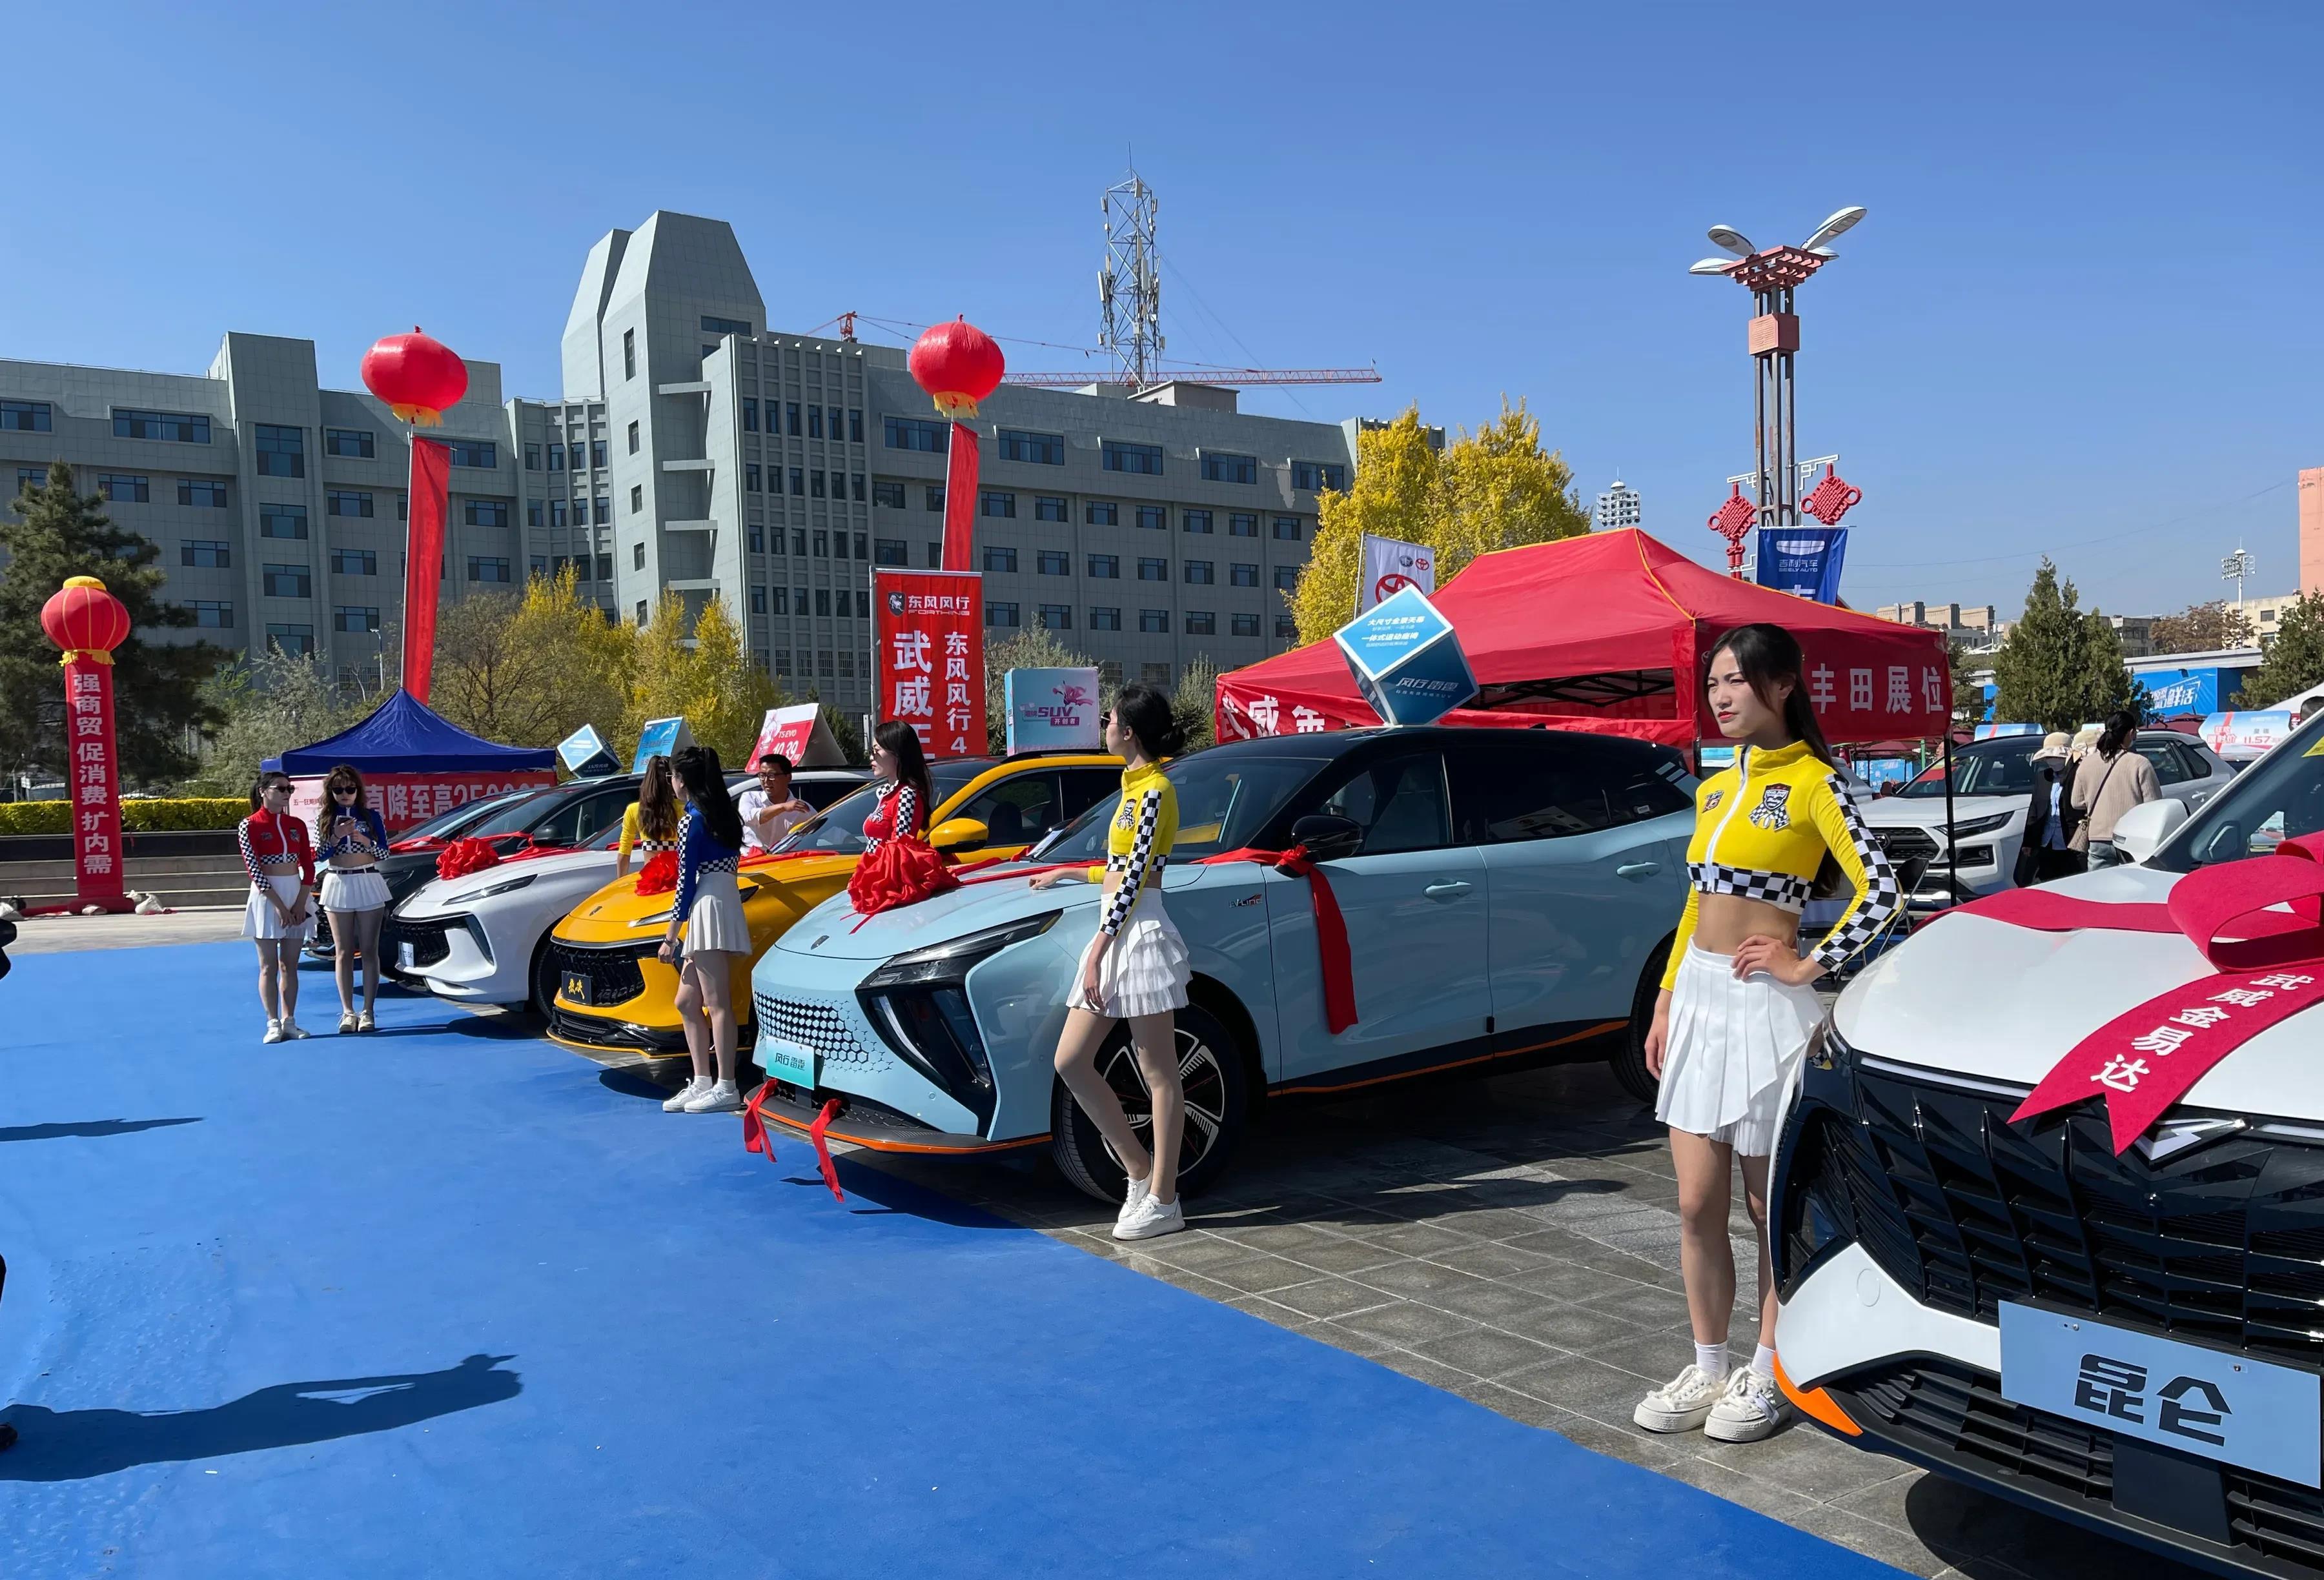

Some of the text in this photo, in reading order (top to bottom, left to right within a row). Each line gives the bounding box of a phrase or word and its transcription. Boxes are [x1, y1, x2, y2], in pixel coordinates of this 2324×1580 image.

[1779, 559, 1819, 568] 吉利汽车
[908, 595, 970, 609] 东风风行
[944, 631, 972, 754] 东风风行4
[1810, 663, 1944, 714] 丰田展位
[72, 673, 112, 875] 强商贸 促消费 扩内需
[773, 740, 799, 761] 1039
[2090, 973, 2316, 1093] 武威金易达
[2074, 1353, 2234, 1448] 昆仑
